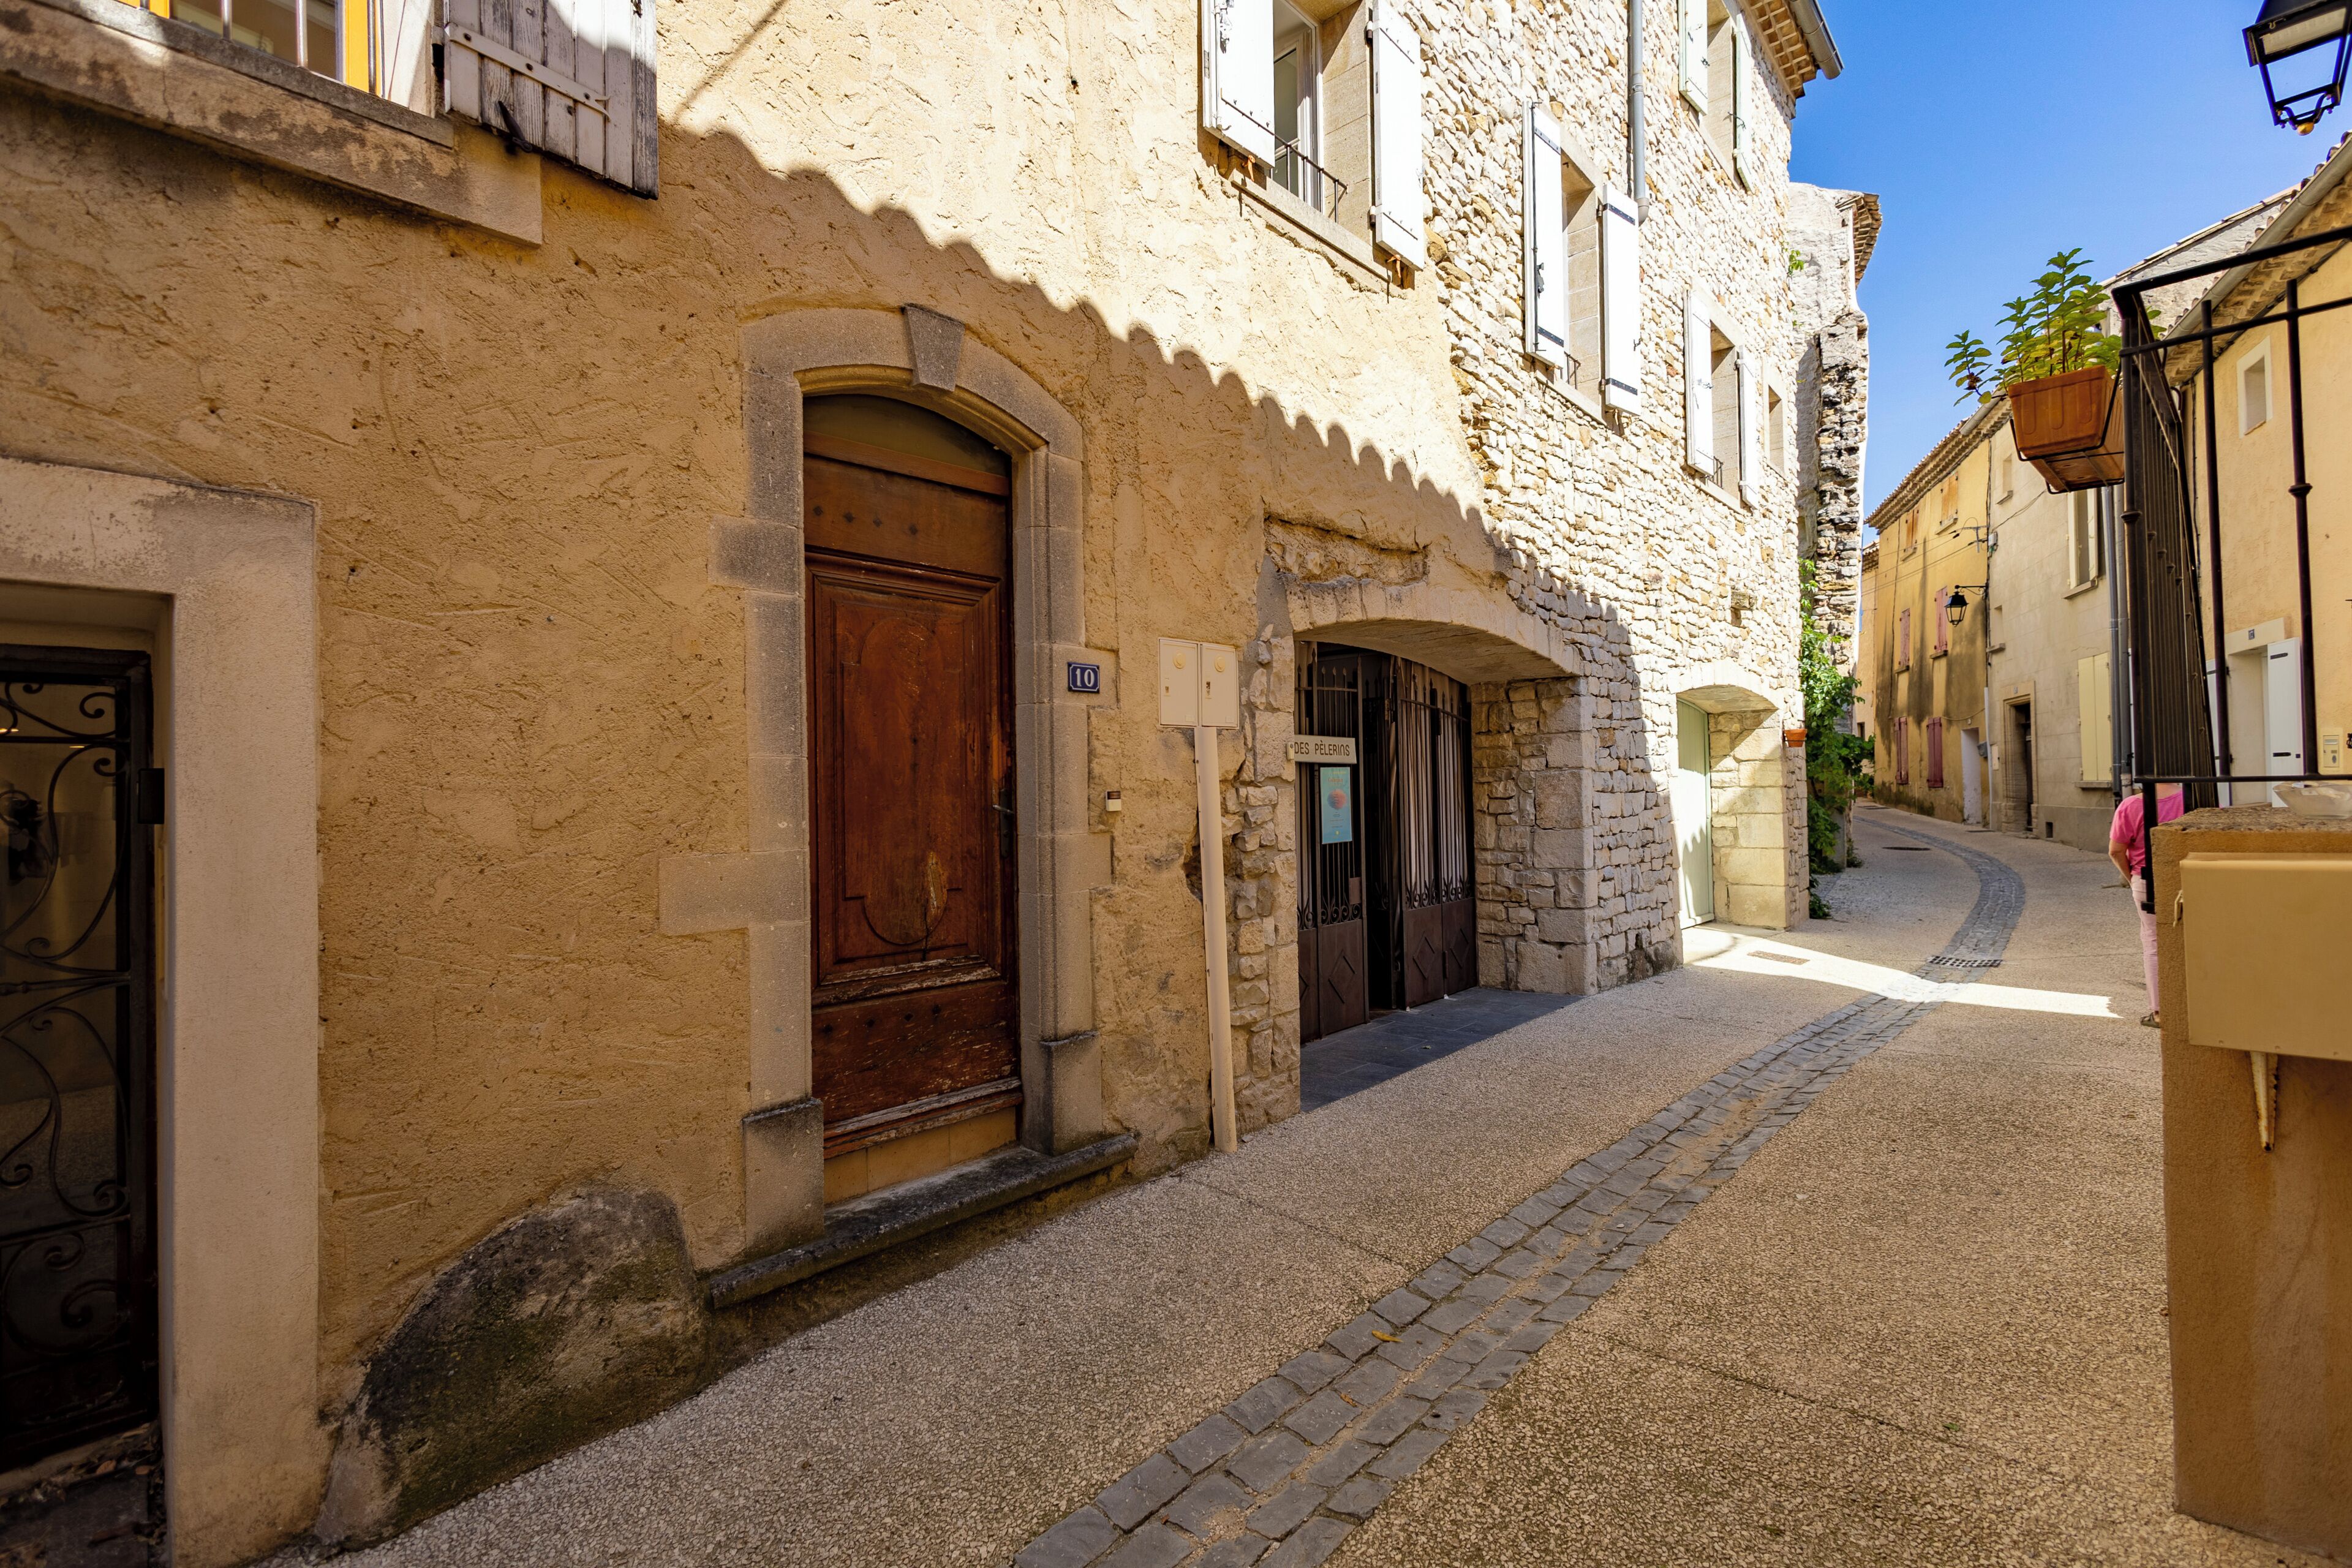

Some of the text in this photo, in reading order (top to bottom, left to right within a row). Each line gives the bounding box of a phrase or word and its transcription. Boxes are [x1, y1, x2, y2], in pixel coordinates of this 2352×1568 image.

[1076, 668, 1095, 687] 10
[1294, 740, 1350, 756] DES PÈLERINS
